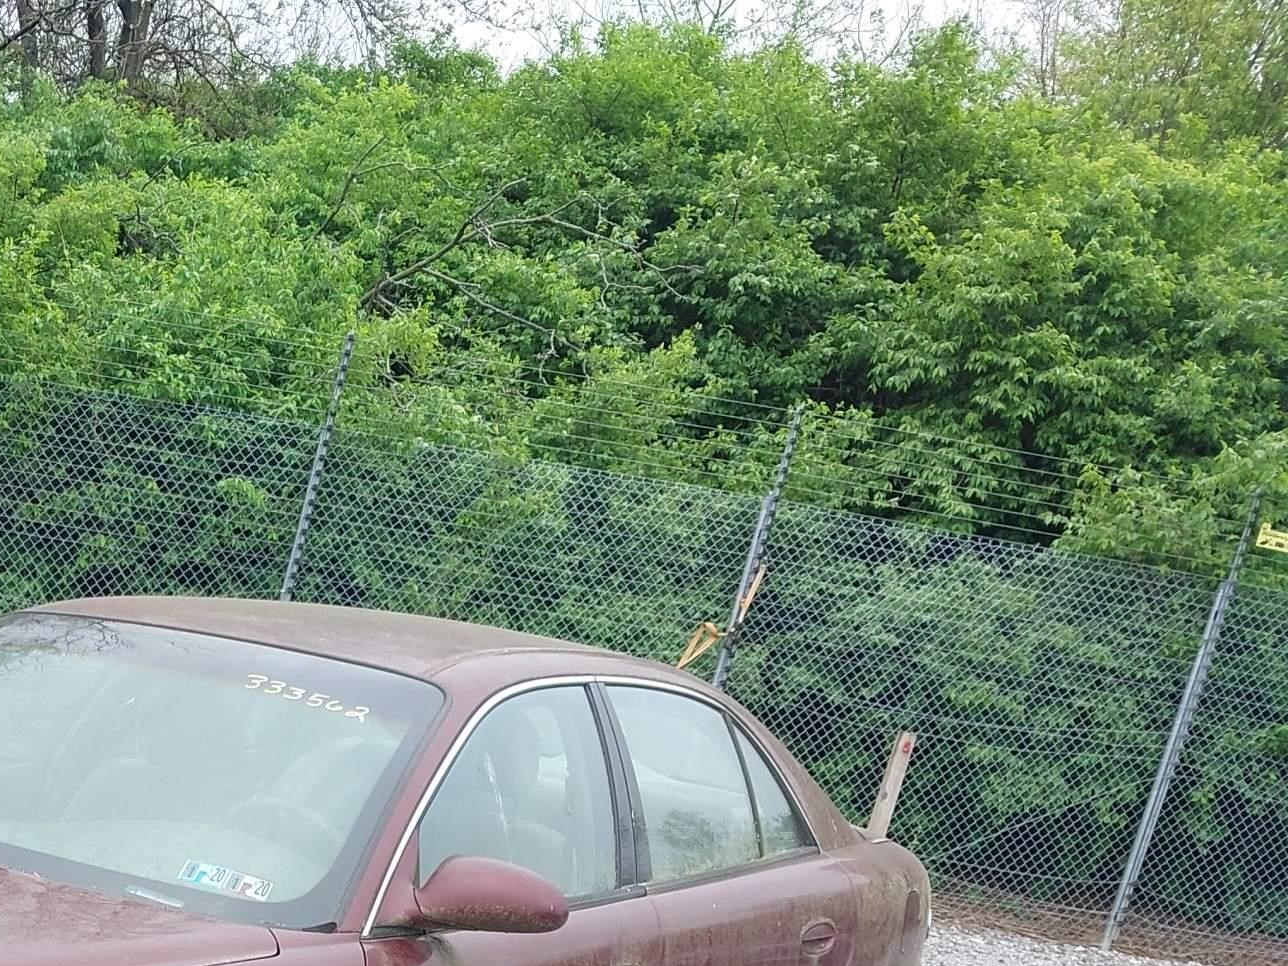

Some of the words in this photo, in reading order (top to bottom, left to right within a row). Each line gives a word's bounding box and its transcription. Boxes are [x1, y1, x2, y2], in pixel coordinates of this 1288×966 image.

[244, 673, 370, 723] 333562
[209, 867, 226, 883] 20
[254, 880, 271, 897] 20
